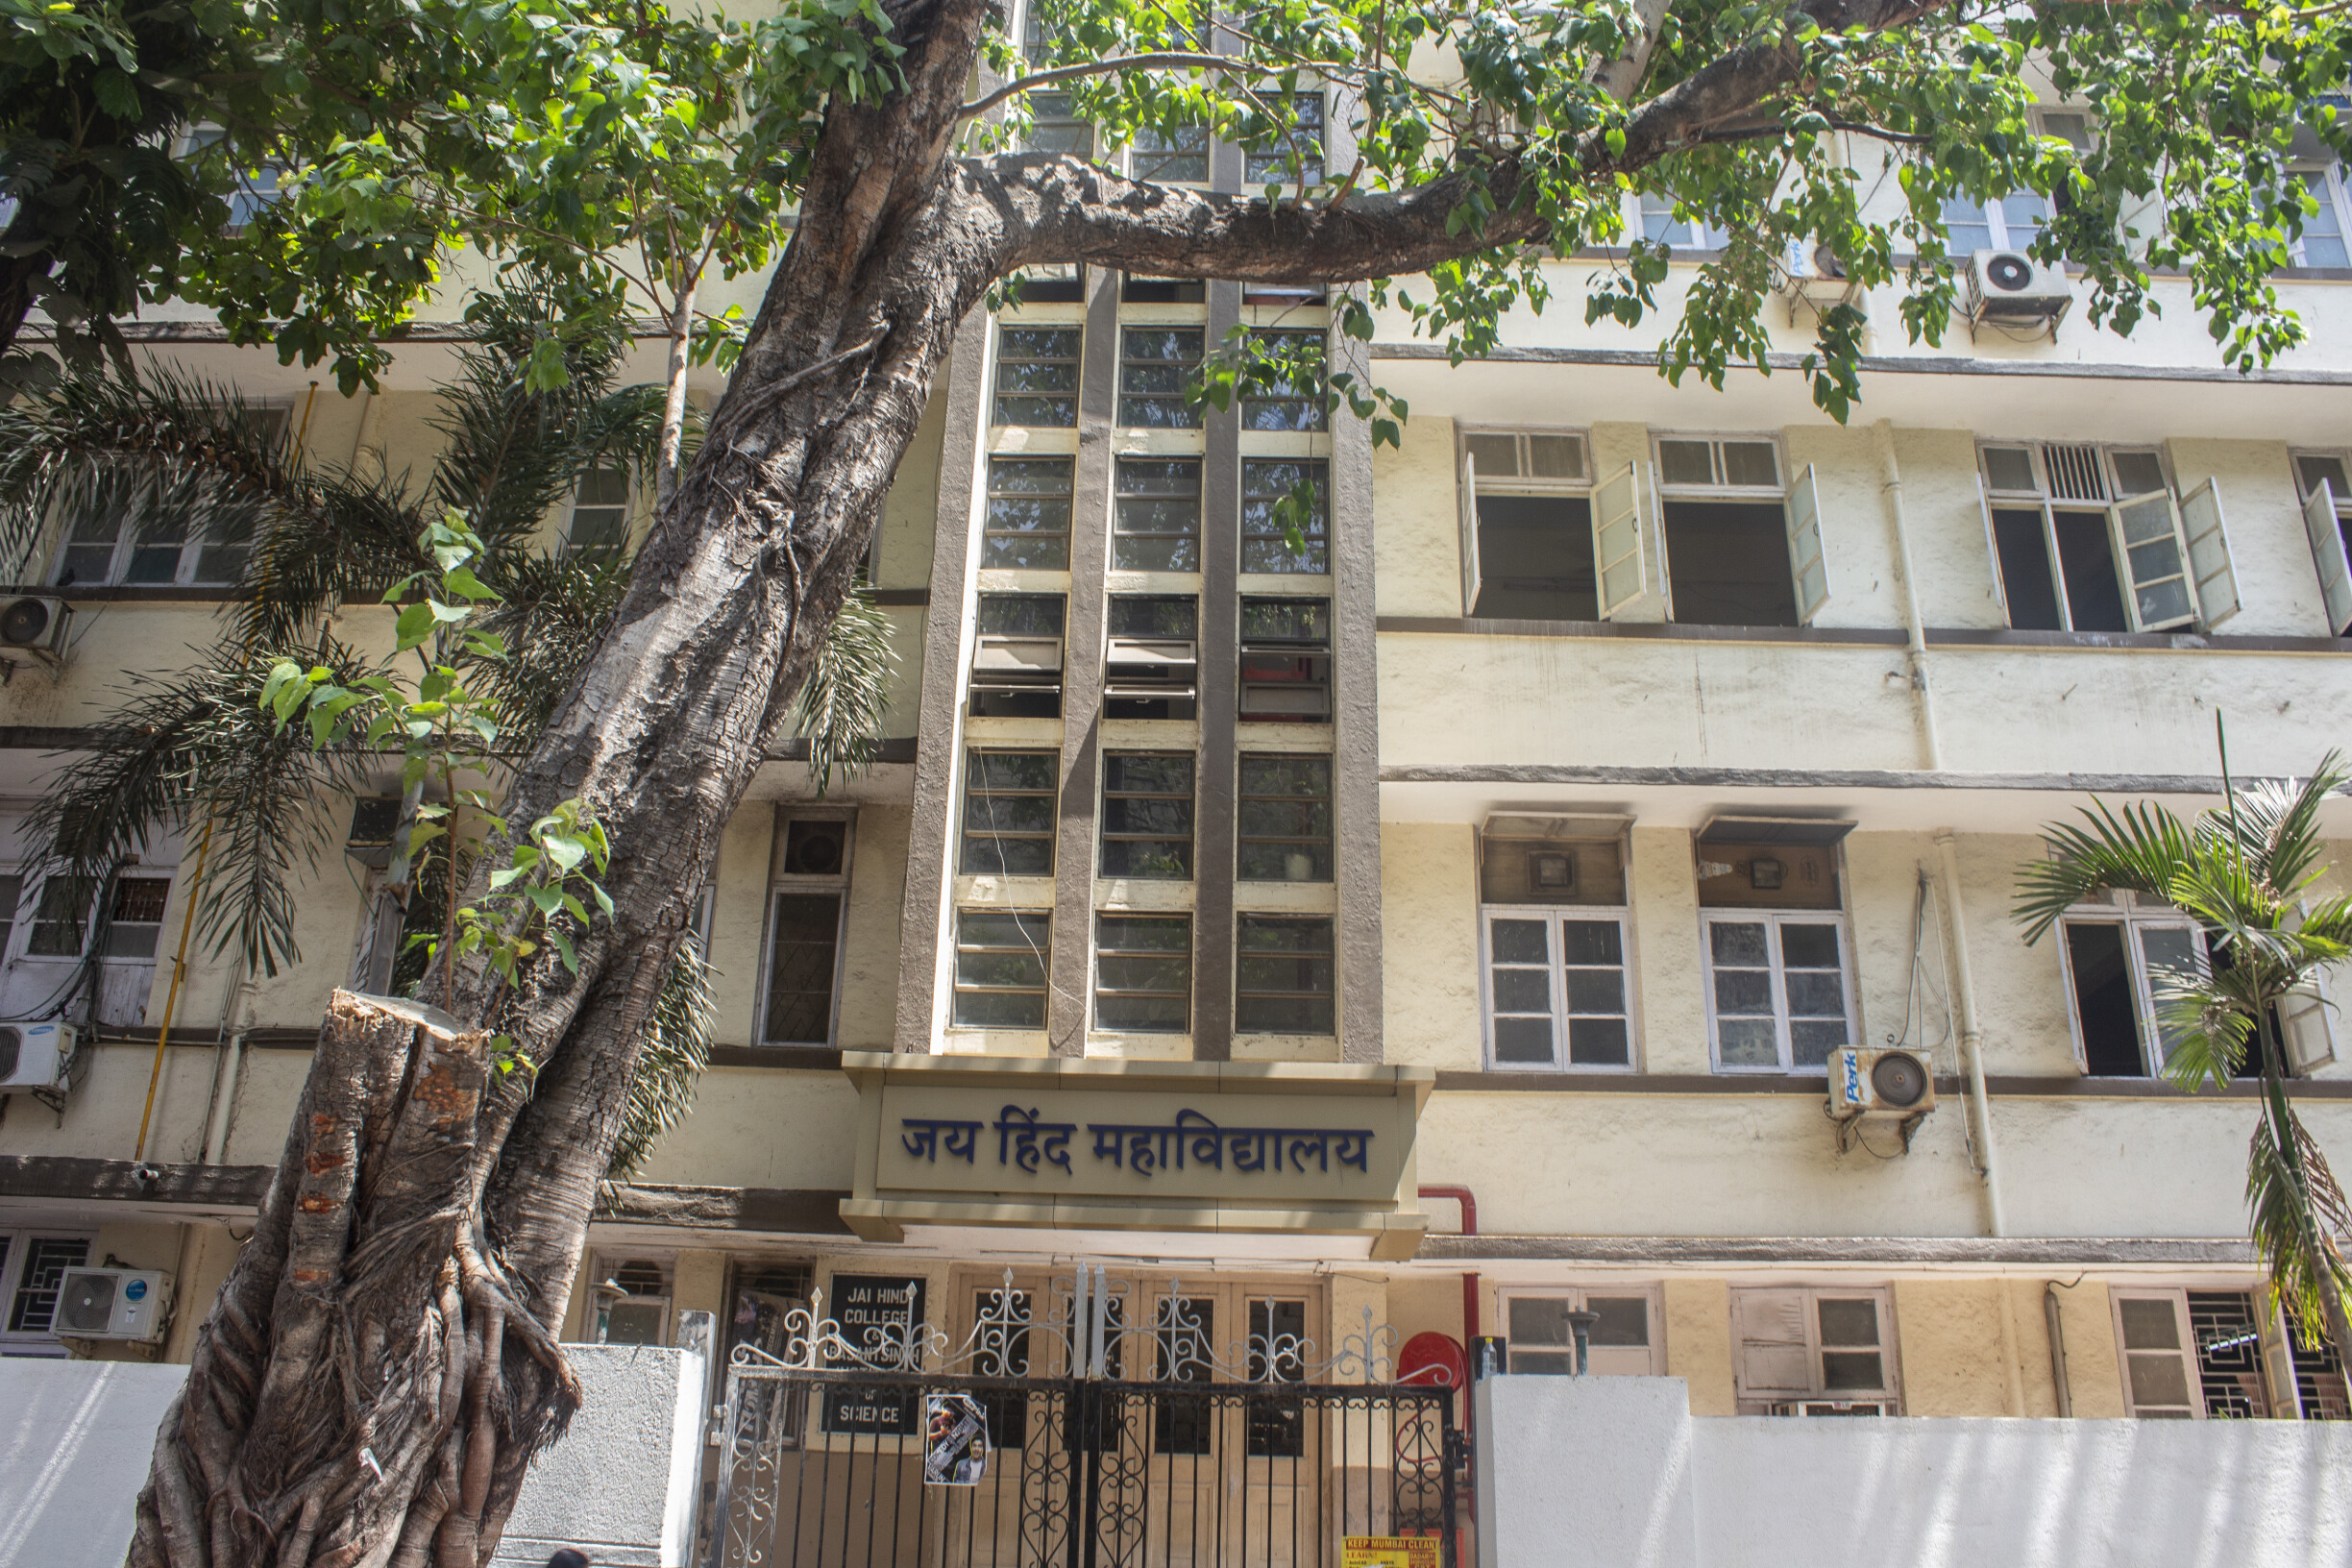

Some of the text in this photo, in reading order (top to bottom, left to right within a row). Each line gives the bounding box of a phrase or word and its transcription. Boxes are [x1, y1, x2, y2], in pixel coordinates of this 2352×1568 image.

[1845, 1052, 1859, 1103] Perk
[901, 1104, 1376, 1177] जय हिंद महाविद्यालय
[847, 1287, 909, 1305] JAI HIND
[845, 1309, 908, 1325] COLLEGE
[871, 1331, 879, 1340] &
[829, 1345, 919, 1363] BASANTSINH
[1348, 1538, 1434, 1550] KEEP MUMBAI CLEAN
